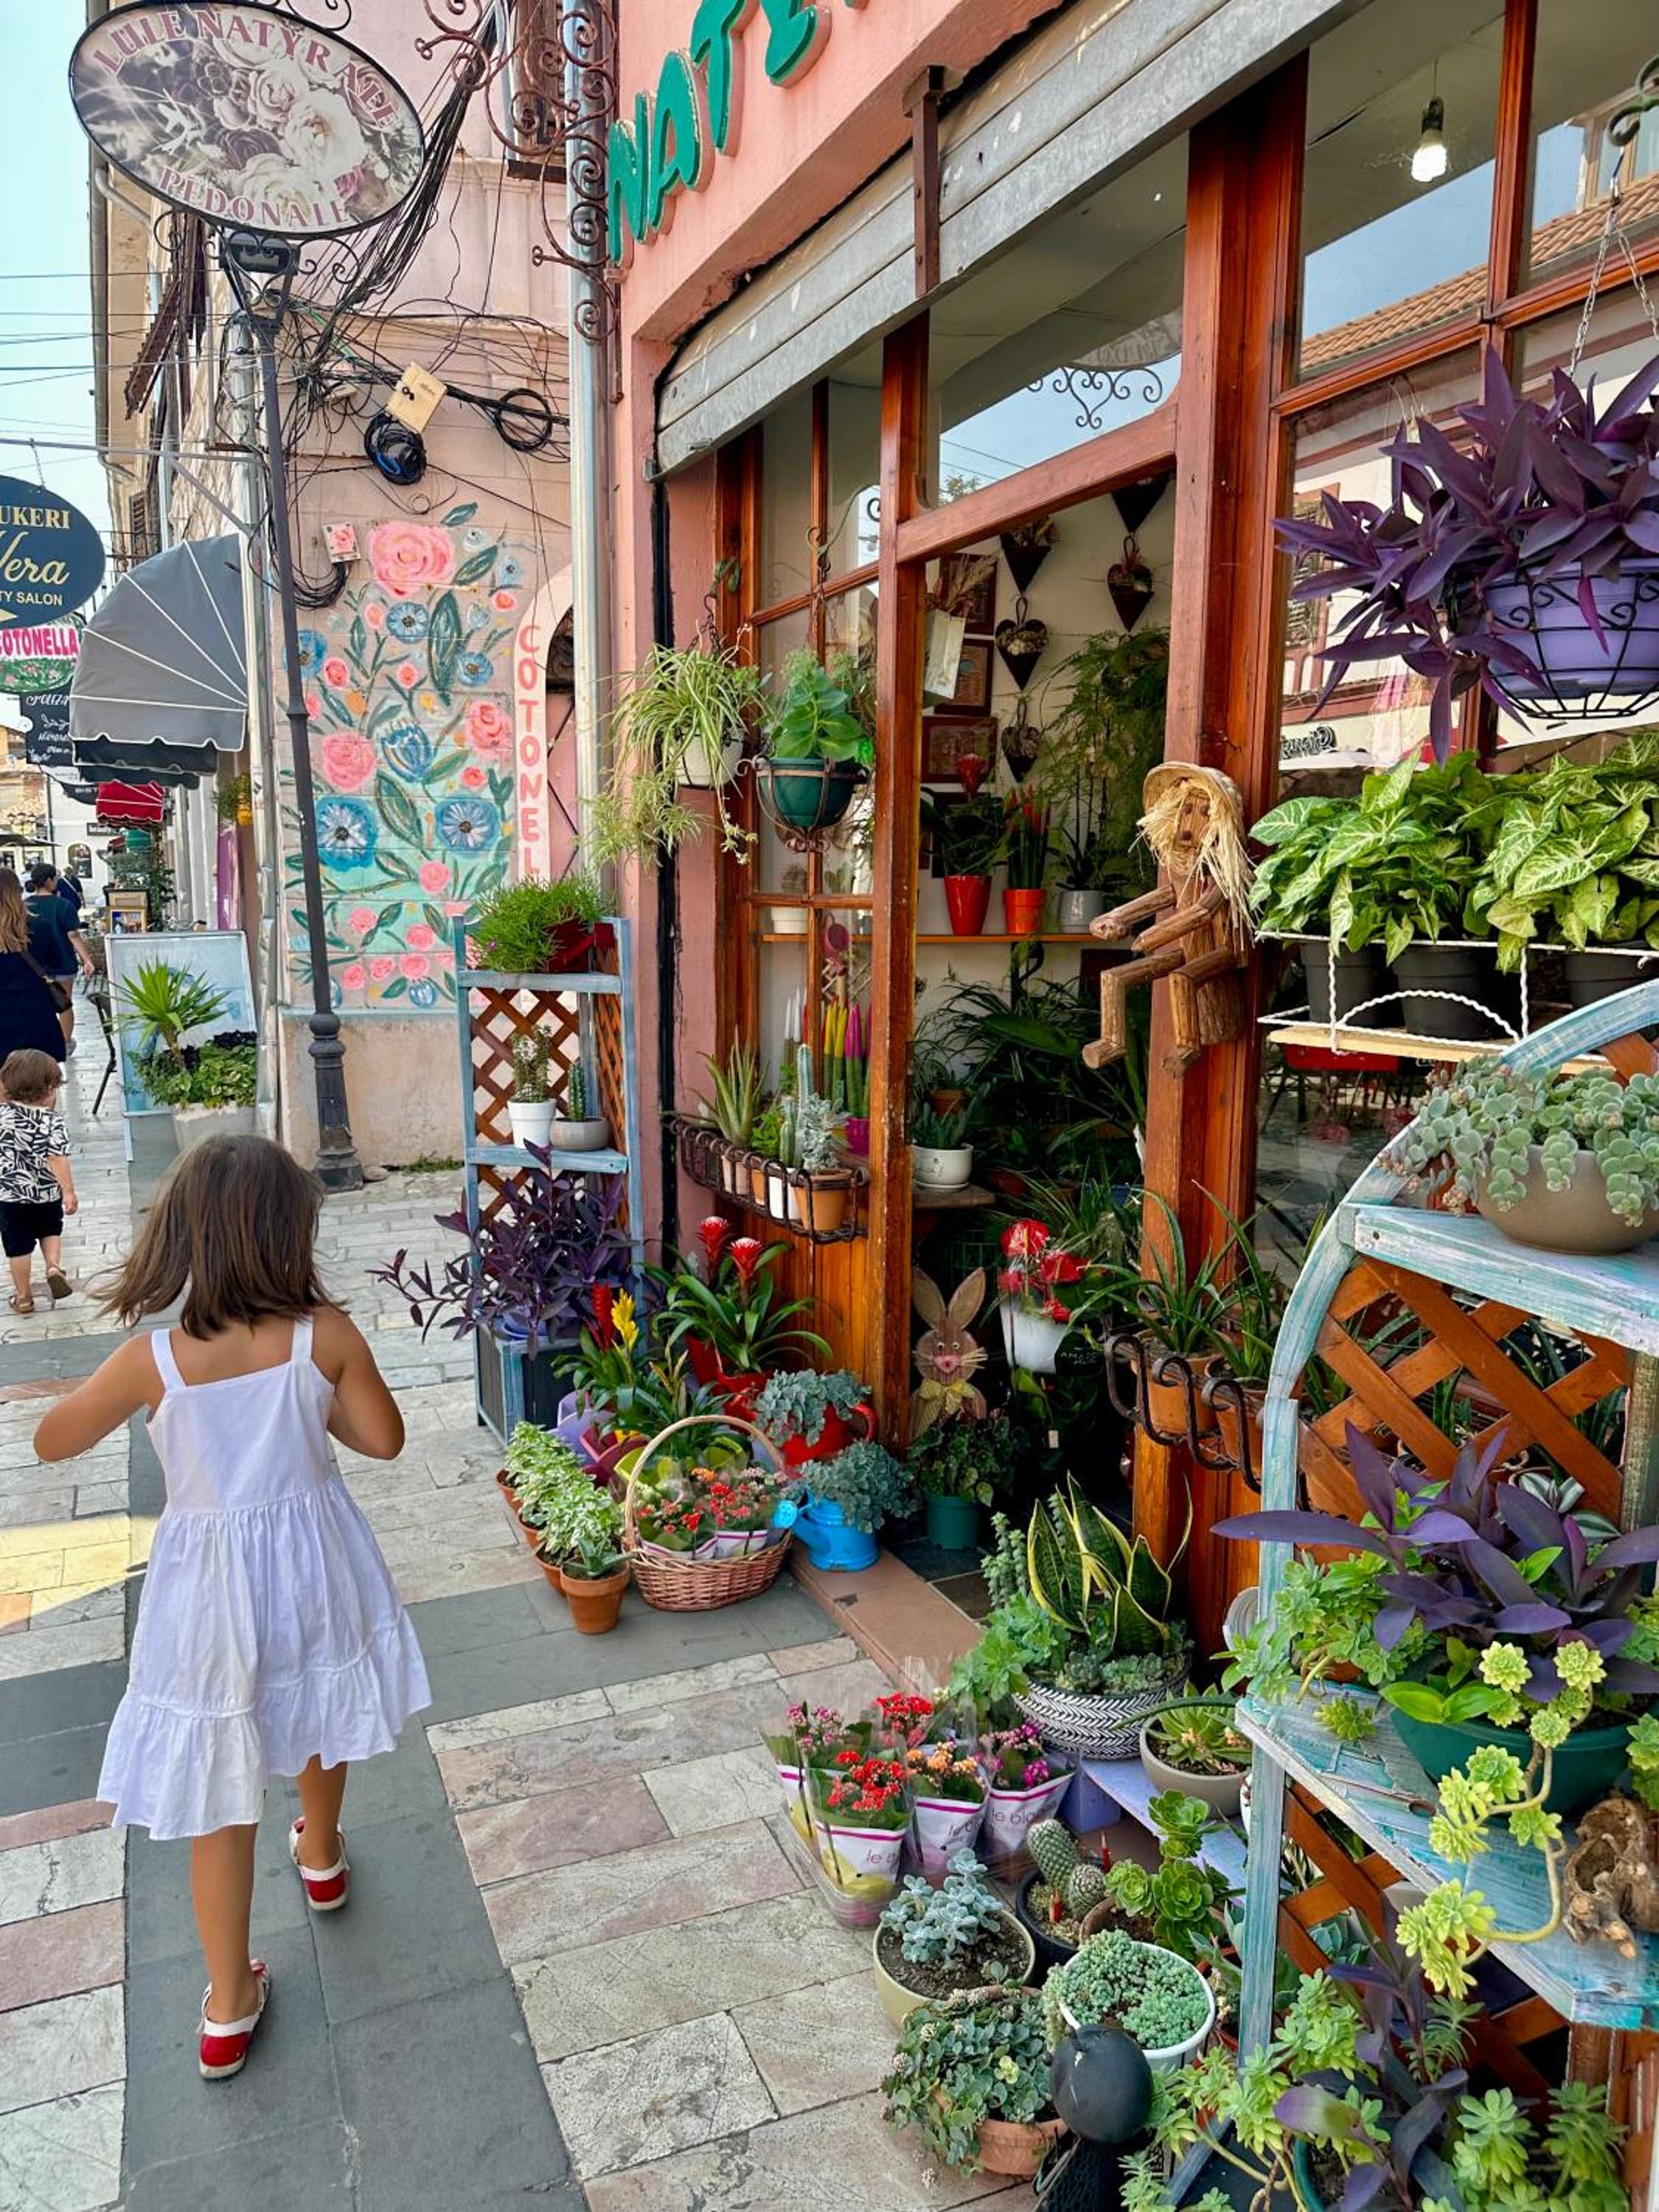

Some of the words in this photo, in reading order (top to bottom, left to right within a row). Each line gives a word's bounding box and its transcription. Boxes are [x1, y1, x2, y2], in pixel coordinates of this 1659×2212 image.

[93, 10, 186, 74] LULE
[193, 10, 403, 131] NATYRALE
[158, 166, 349, 227] PEDONALE
[16, 592, 63, 605] SALON
[0, 627, 78, 656] OTONELLA
[866, 1849, 883, 1865] le
